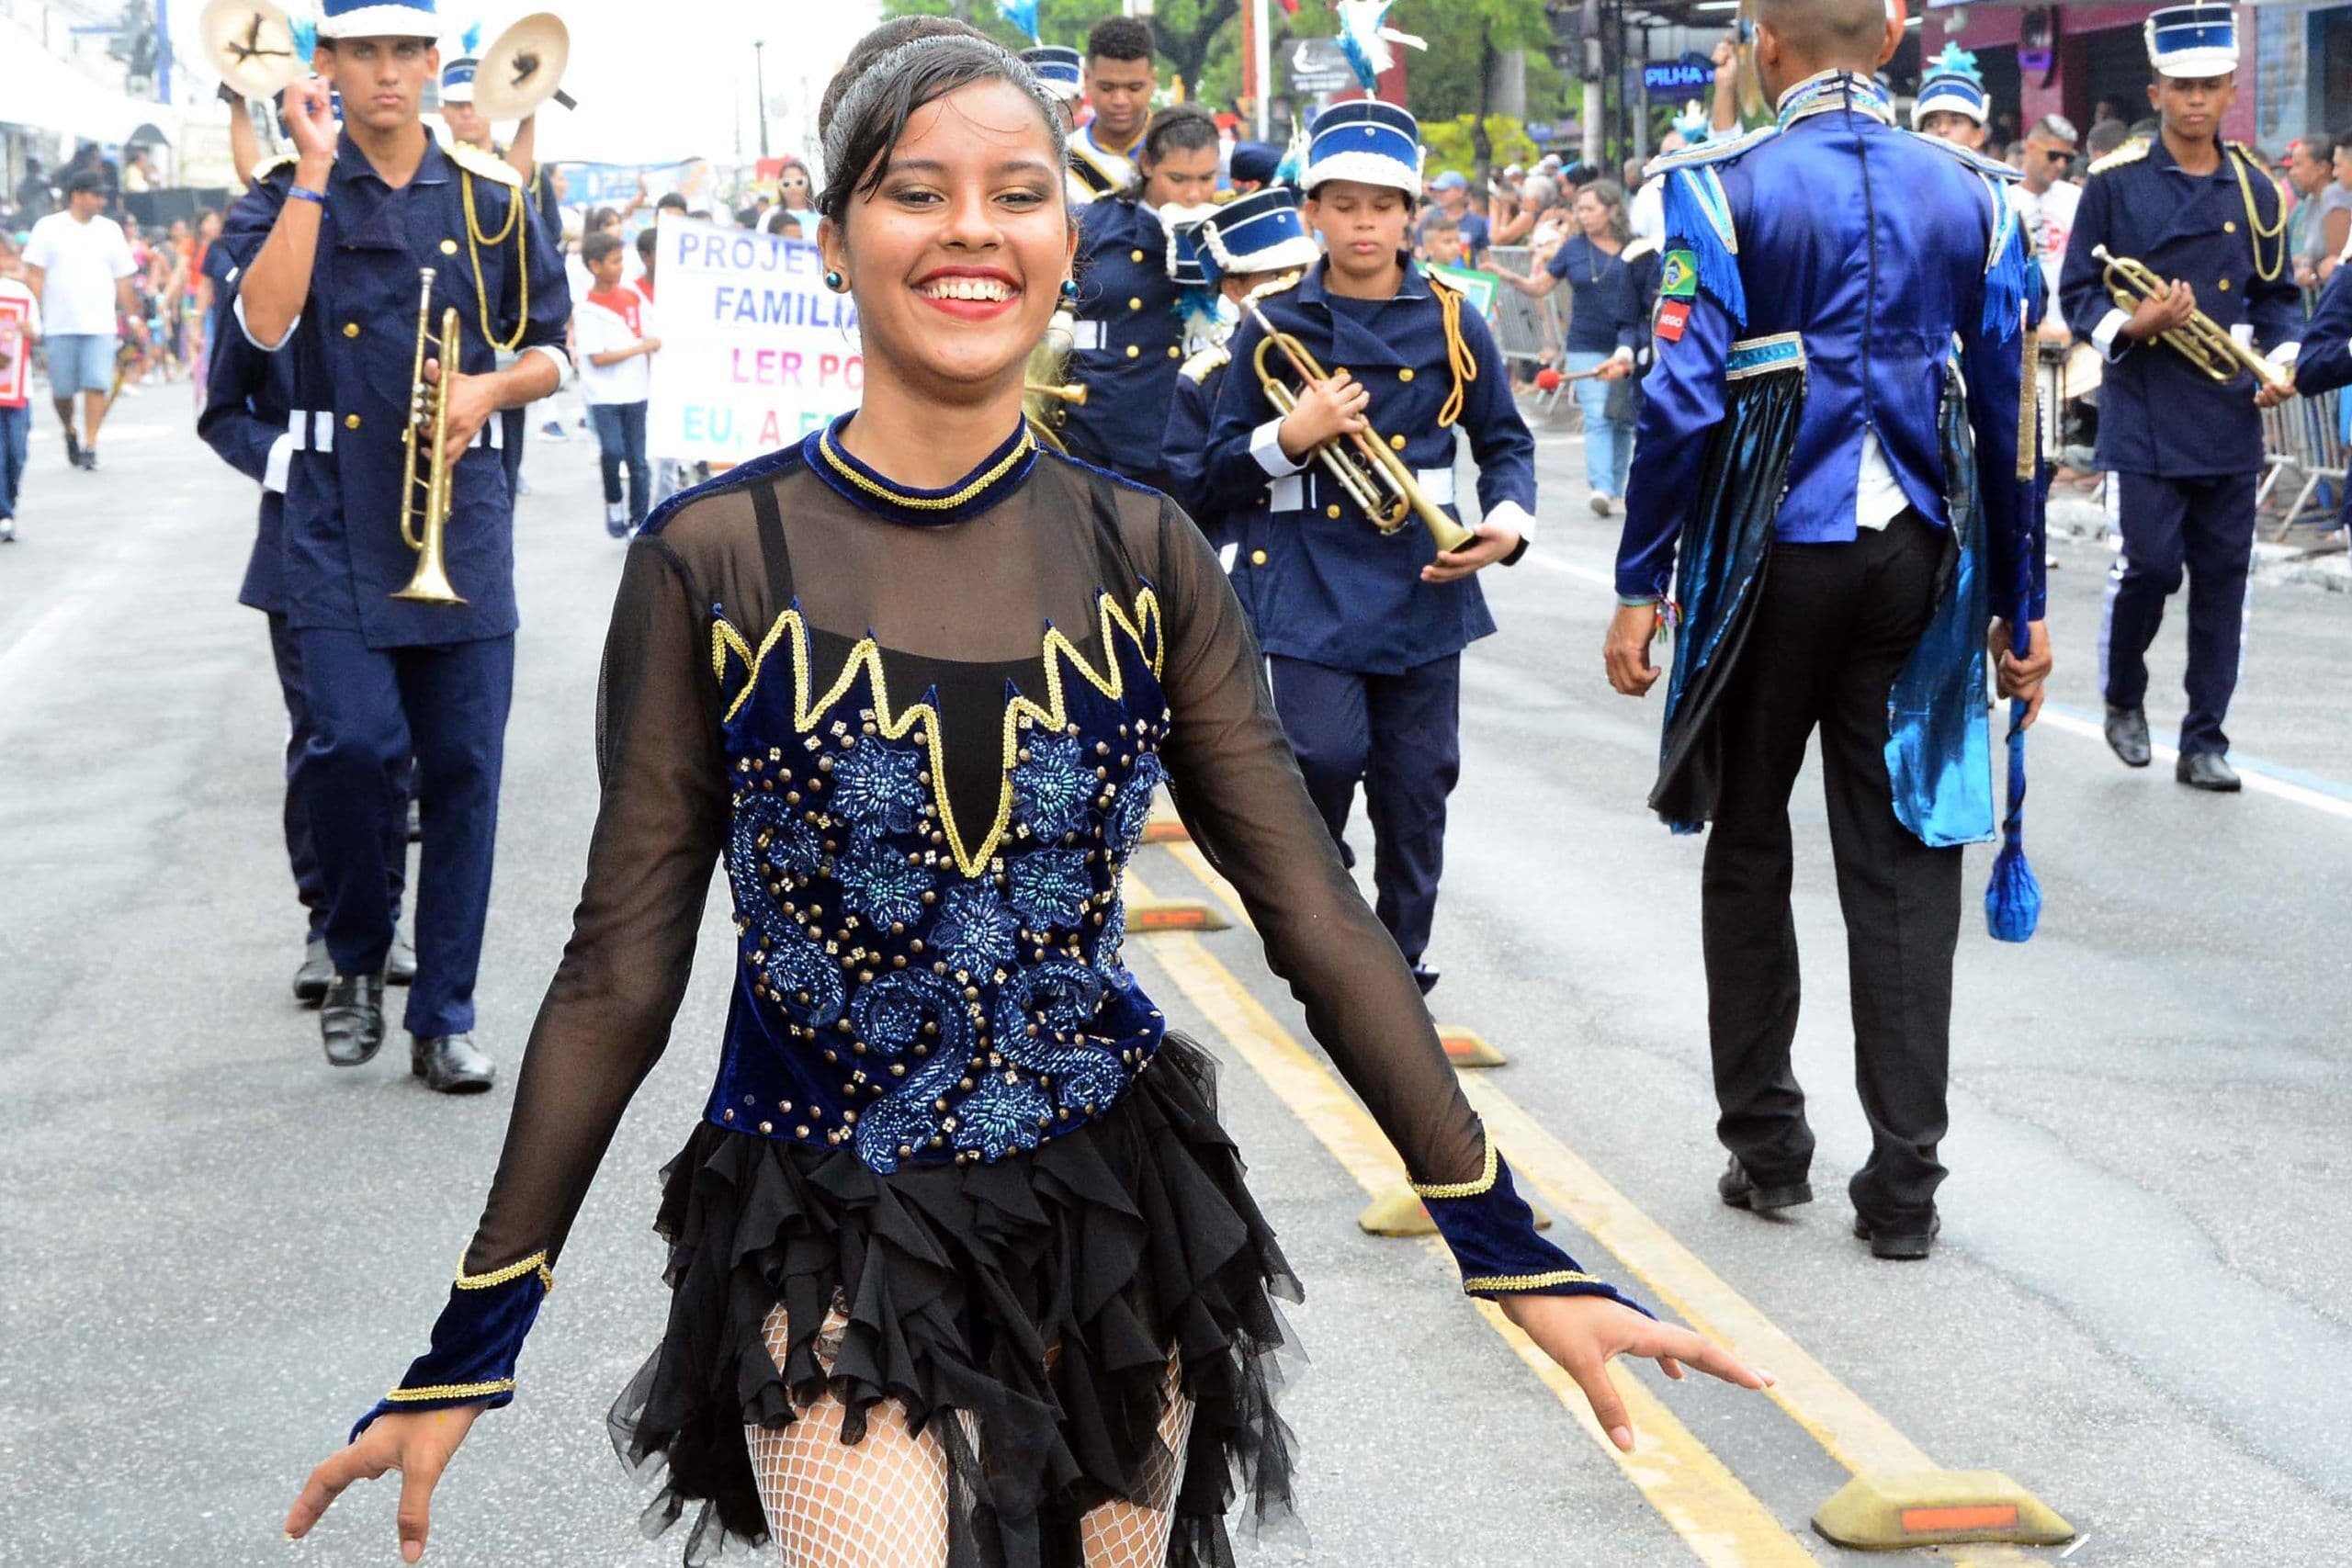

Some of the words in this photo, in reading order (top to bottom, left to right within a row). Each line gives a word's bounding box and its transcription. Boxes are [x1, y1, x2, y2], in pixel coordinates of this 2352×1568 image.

[1645, 65, 1703, 87] PILHA
[731, 347, 802, 387] LER
[759, 410, 781, 446] A
